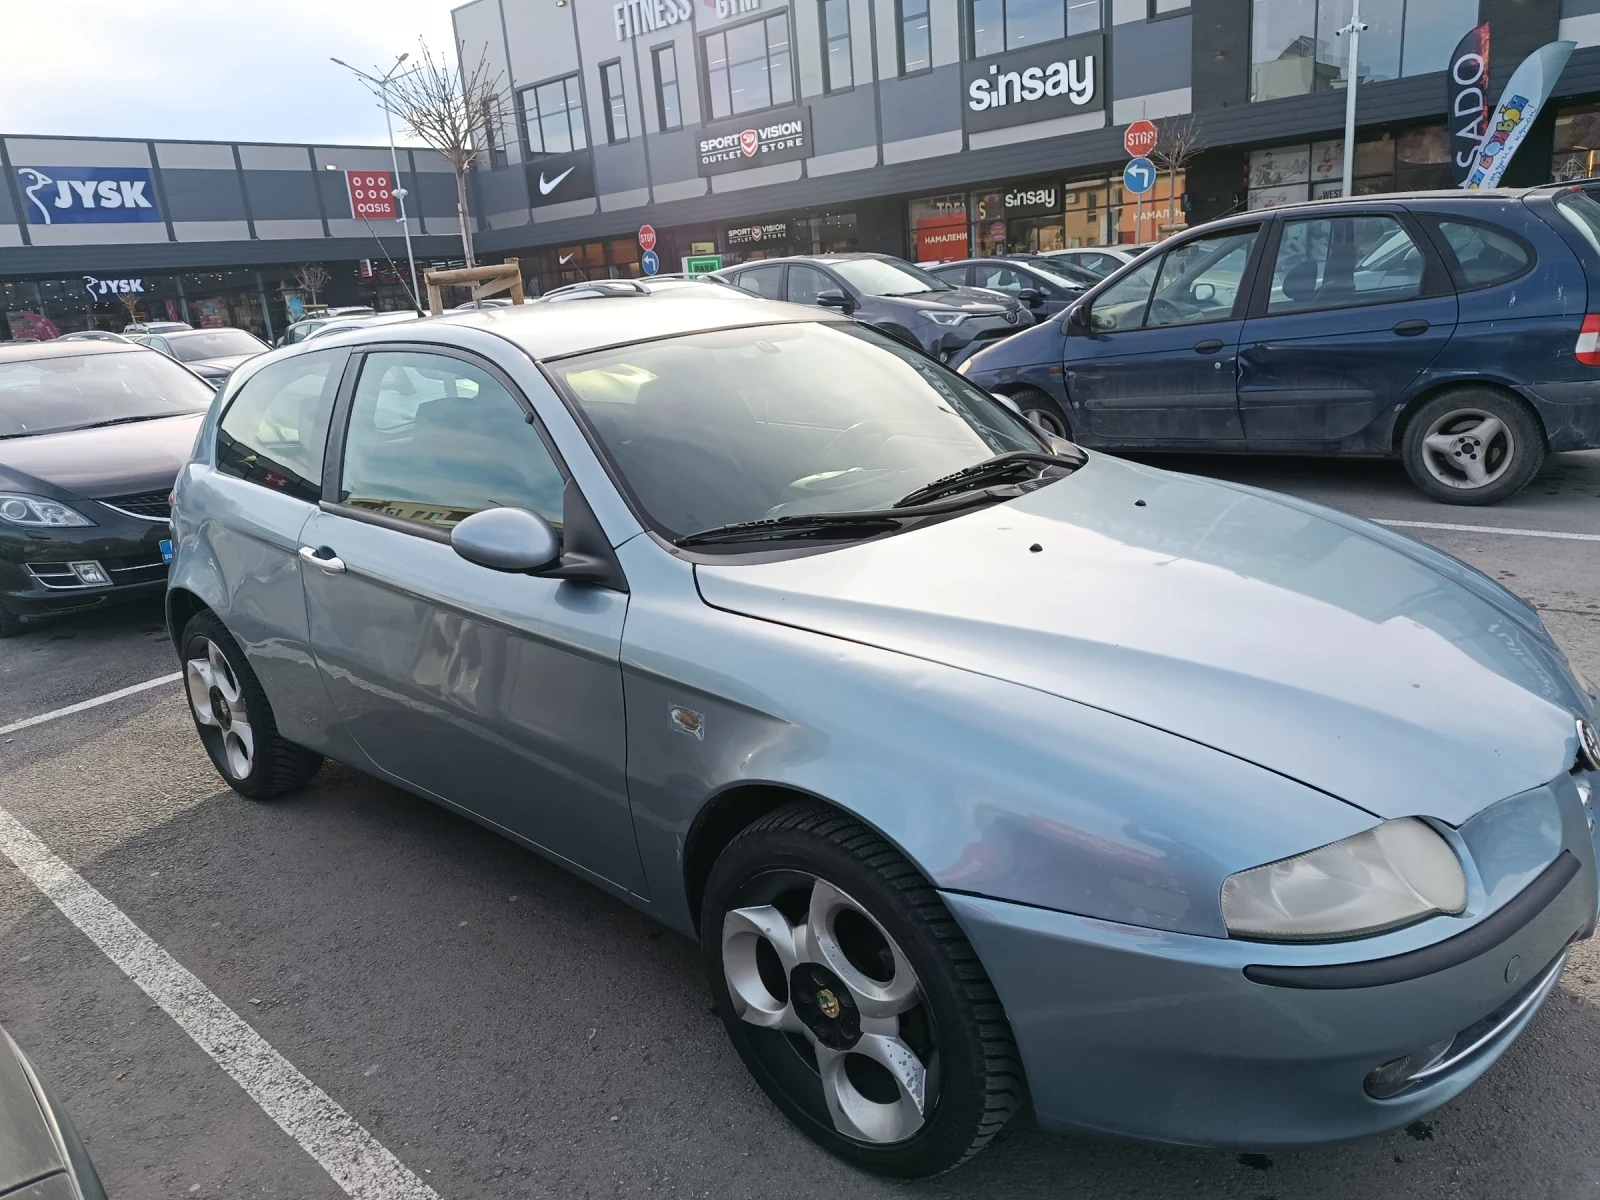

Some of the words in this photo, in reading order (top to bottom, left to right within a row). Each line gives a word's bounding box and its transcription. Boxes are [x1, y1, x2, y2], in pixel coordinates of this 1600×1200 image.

[613, 0, 692, 41] FITNESS
[969, 55, 1094, 111] sinsay
[700, 134, 740, 152] SPORT
[758, 120, 803, 139] VISION
[1128, 131, 1154, 146] STOP
[702, 150, 742, 164] OUTLET
[761, 138, 803, 153] STORE
[54, 180, 152, 208] JYSK
[1005, 188, 1055, 208] sinsay
[357, 203, 391, 213] oasis
[1133, 208, 1186, 222] НАМАЛН
[728, 227, 752, 237] SPORT
[762, 223, 786, 233] VISION
[640, 233, 654, 244] STOP
[729, 236, 752, 244] OUTLET
[763, 233, 787, 241] STORE
[694, 264, 715, 273] PARK
[99, 279, 144, 295] JYSK
